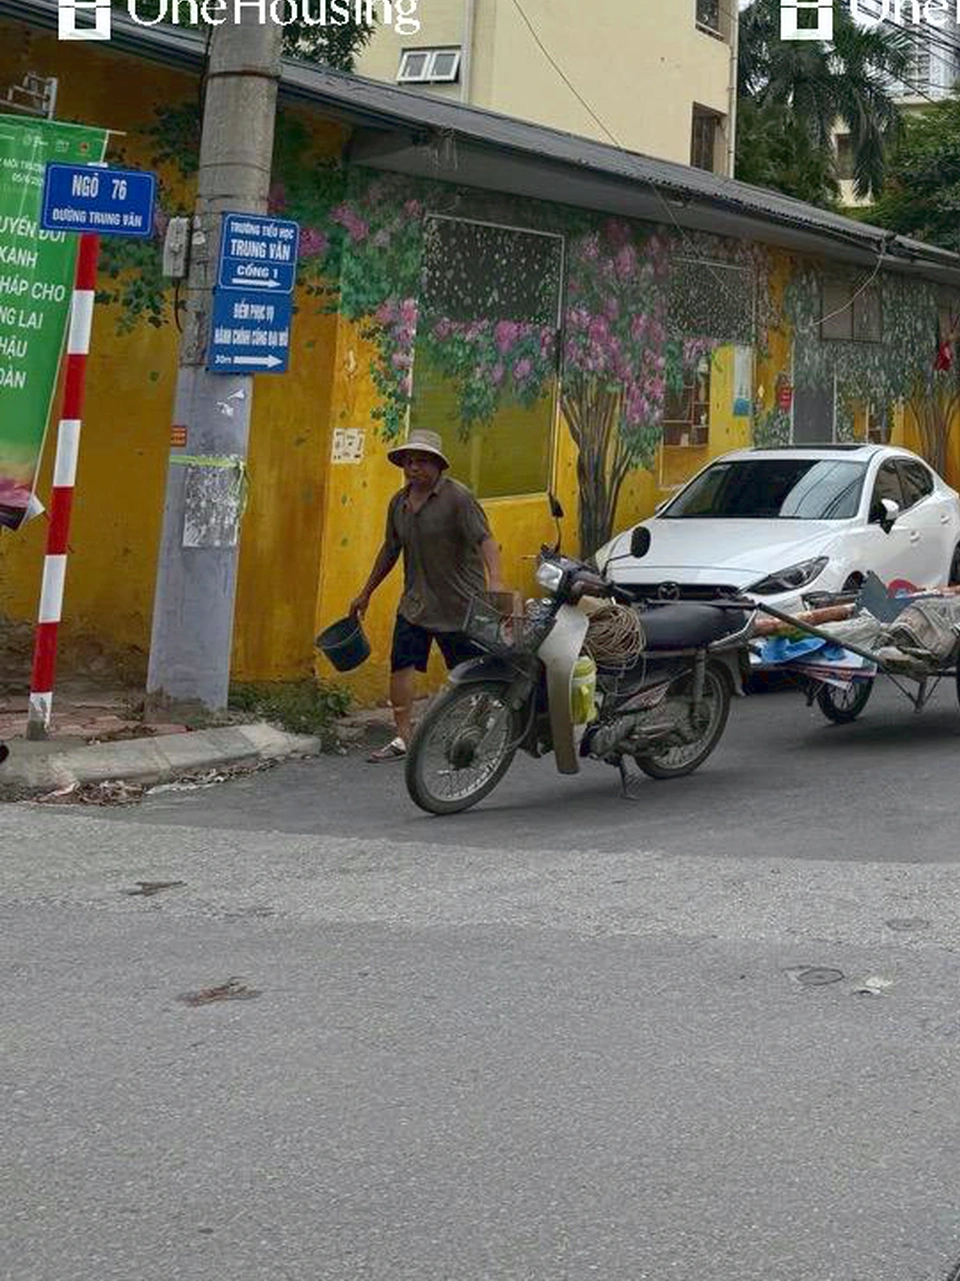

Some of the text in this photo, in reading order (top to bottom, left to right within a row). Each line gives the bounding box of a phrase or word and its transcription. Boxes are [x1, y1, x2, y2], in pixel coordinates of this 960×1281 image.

[71, 172, 128, 200] NGÕ 76
[89, 211, 121, 226] TRUNG
[122, 211, 143, 227] VĂN
[230, 239, 291, 261] TRUNG VĂN
[236, 263, 279, 279] CỐNG 1
[31, 282, 66, 302] CHO
[18, 309, 44, 329] LAI
